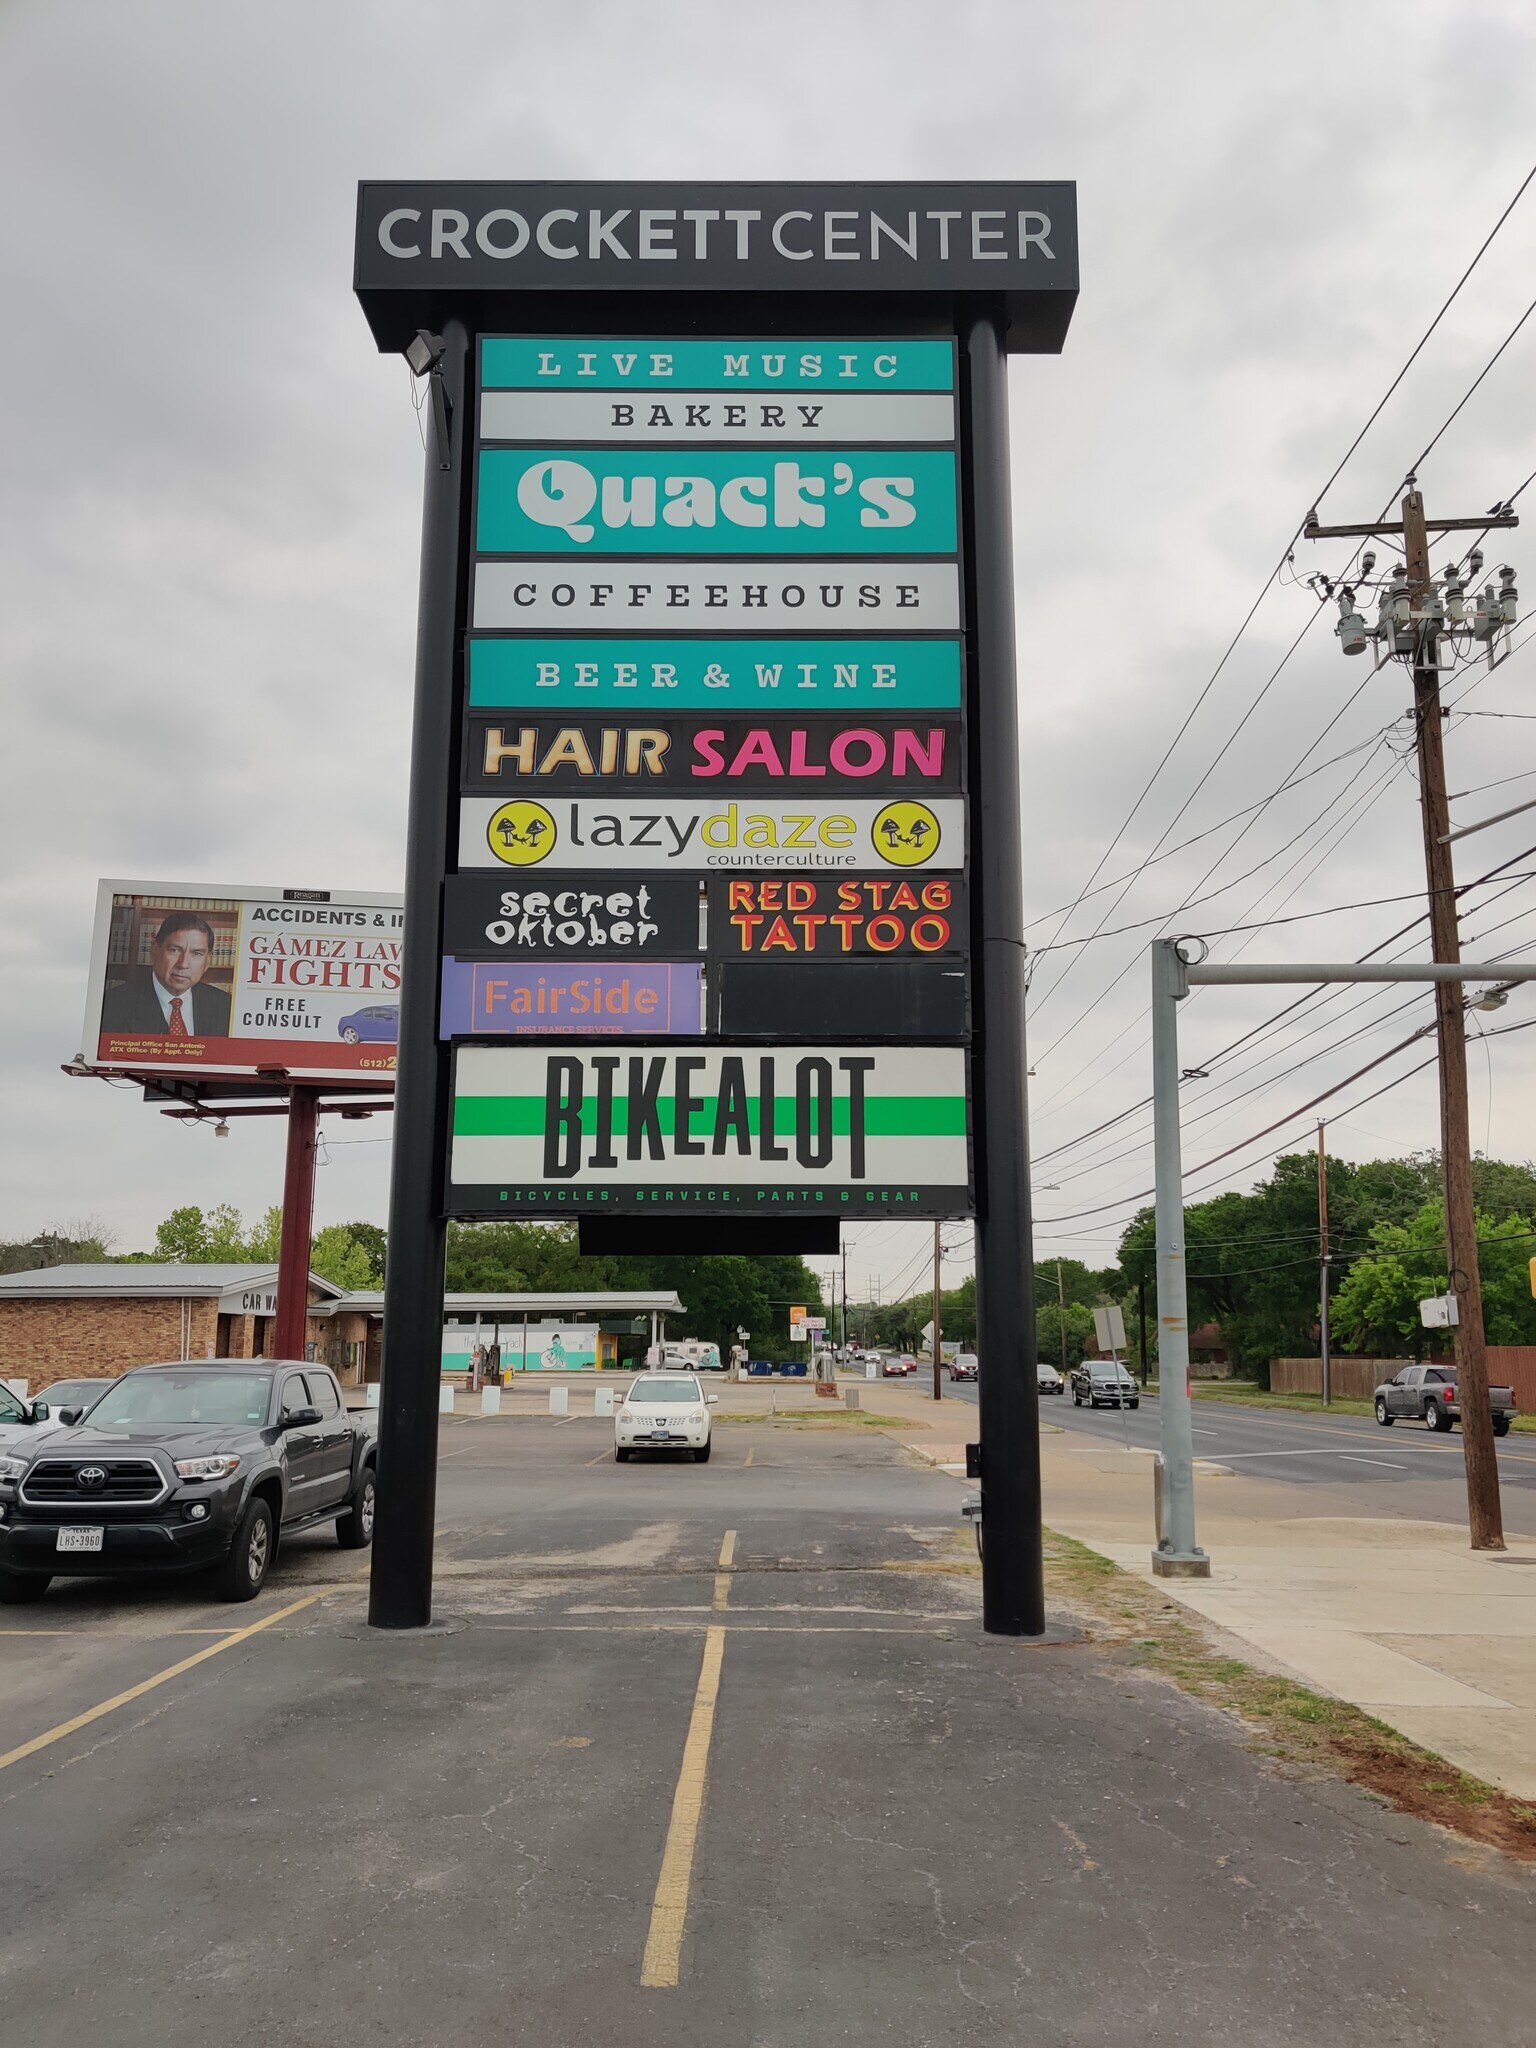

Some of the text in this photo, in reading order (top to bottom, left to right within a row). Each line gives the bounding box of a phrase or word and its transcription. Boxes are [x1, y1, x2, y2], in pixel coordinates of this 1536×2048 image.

[537, 353, 899, 379] LIVE MUSIC
[611, 405, 825, 428] BAKERY
[517, 459, 917, 543] Quack's
[513, 583, 920, 608] COFFEEHOUSE
[535, 663, 898, 688] BEER & WINE
[482, 727, 946, 778] HAIR SALON
[706, 852, 857, 866] counterculture
[500, 885, 651, 919] secret
[728, 880, 951, 911] RED STAG
[252, 908, 367, 926] ACCIDENTS
[373, 914, 385, 926] &
[485, 913, 659, 947] oktober
[730, 914, 951, 952] TATTOO
[249, 932, 346, 958] GÁMEZ
[247, 957, 401, 990] FIGHTS
[265, 998, 306, 1012] FREE
[485, 978, 658, 1014] FairSide
[243, 1012, 322, 1028] CONSULT
[516, 1026, 623, 1034] INSURANCE SERVICES
[164, 1048, 182, 1056] Appt.
[543, 1056, 875, 1179] BIKEALOT
[500, 1191, 920, 1202] BICYCLES, SERVICE, PARTS & GEAR
[242, 1292, 261, 1310] CAR
